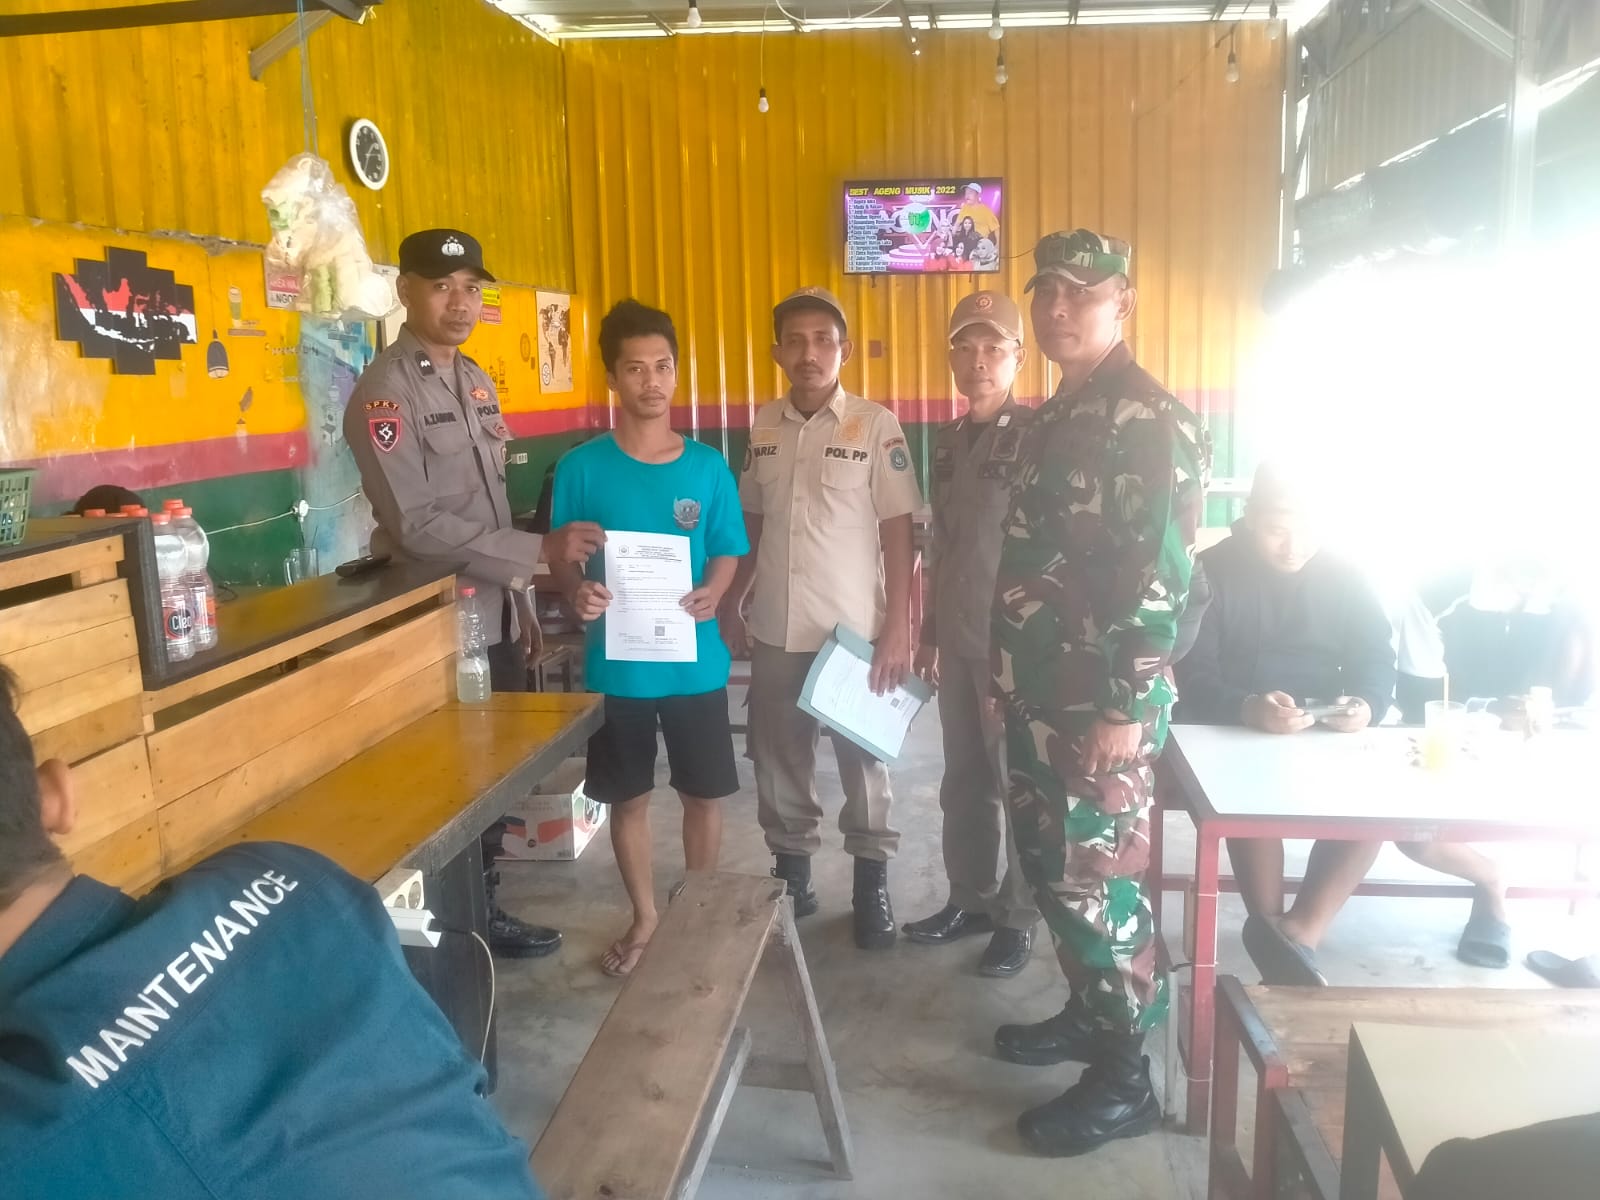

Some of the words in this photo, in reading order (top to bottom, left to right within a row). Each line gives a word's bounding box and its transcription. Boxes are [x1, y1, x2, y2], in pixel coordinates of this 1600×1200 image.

[873, 187, 901, 196] AGENG
[935, 186, 956, 194] 2022
[365, 401, 399, 412] SPKT
[825, 447, 848, 459] POL
[852, 452, 868, 462] PP
[66, 869, 298, 1088] MAINTENANCE
